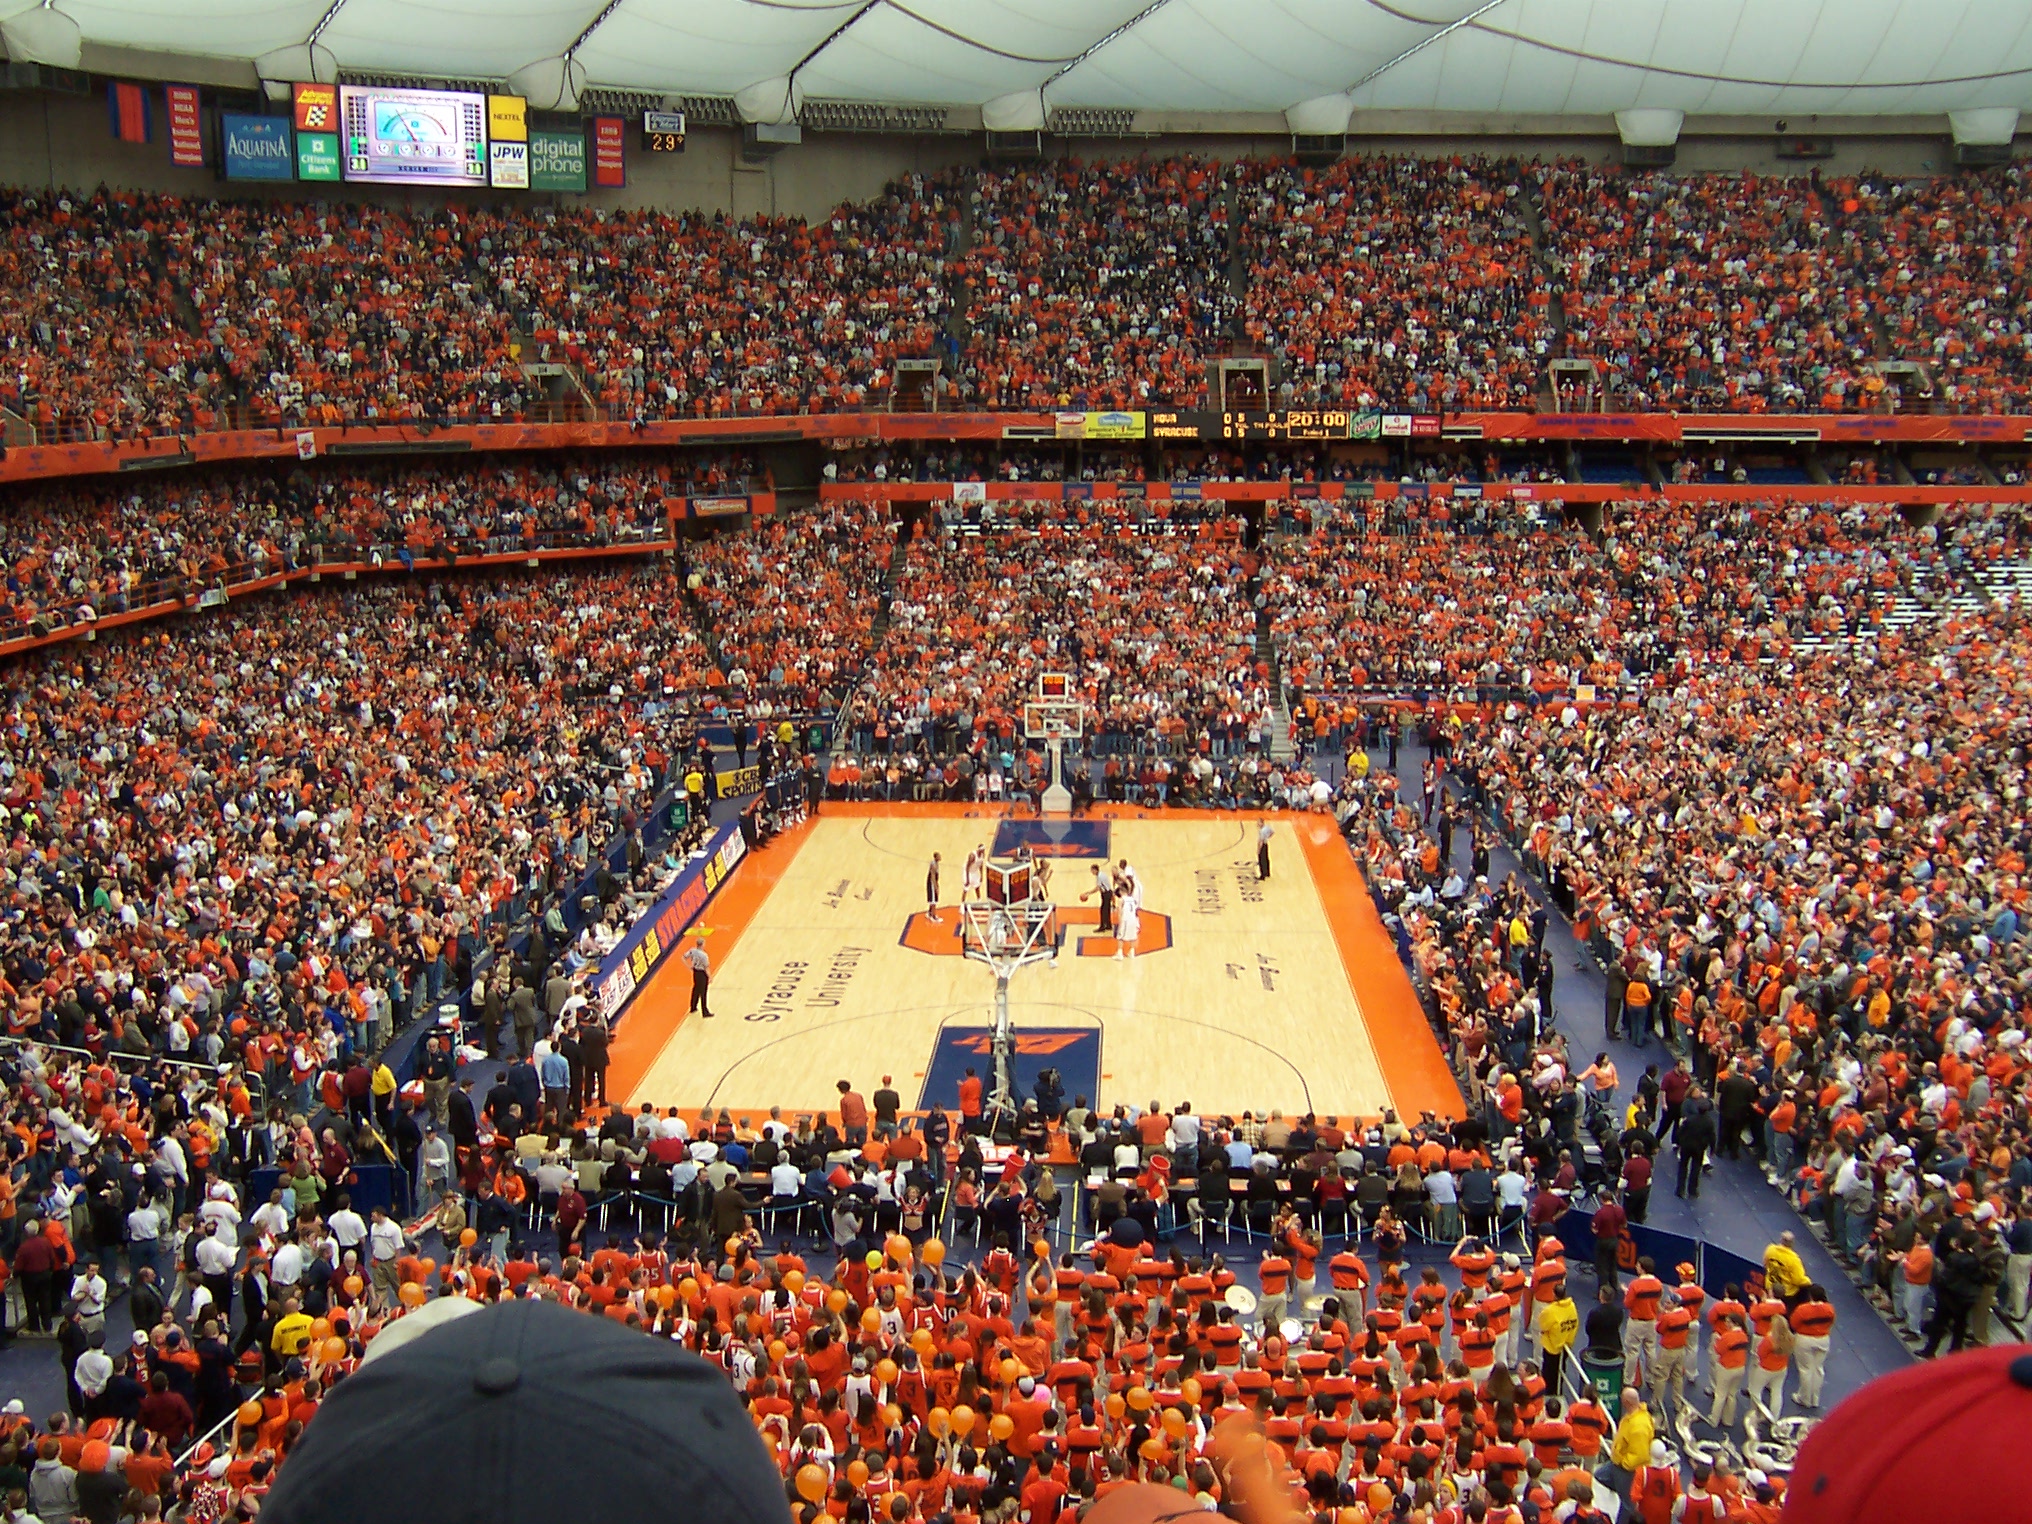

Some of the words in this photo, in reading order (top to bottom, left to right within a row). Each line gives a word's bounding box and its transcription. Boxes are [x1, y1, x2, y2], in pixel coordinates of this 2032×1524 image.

[493, 113, 521, 122] NEXTEL
[493, 146, 525, 160] JPW
[533, 138, 582, 162] digital
[301, 154, 336, 165] Citizens
[532, 156, 583, 175] phone
[308, 164, 331, 174] Bank
[1290, 413, 1345, 427] 20:00
[1153, 427, 1198, 437] SYRACUSE
[805, 945, 872, 1008] University
[744, 961, 809, 1023] Syracuse
[887, 1321, 897, 1335] 3
[924, 1316, 934, 1331] 3
[141, 1370, 149, 1383] 3
[734, 1364, 740, 1378] 3
[1101, 1466, 1111, 1481] 3
[1461, 1488, 1471, 1505] 3
